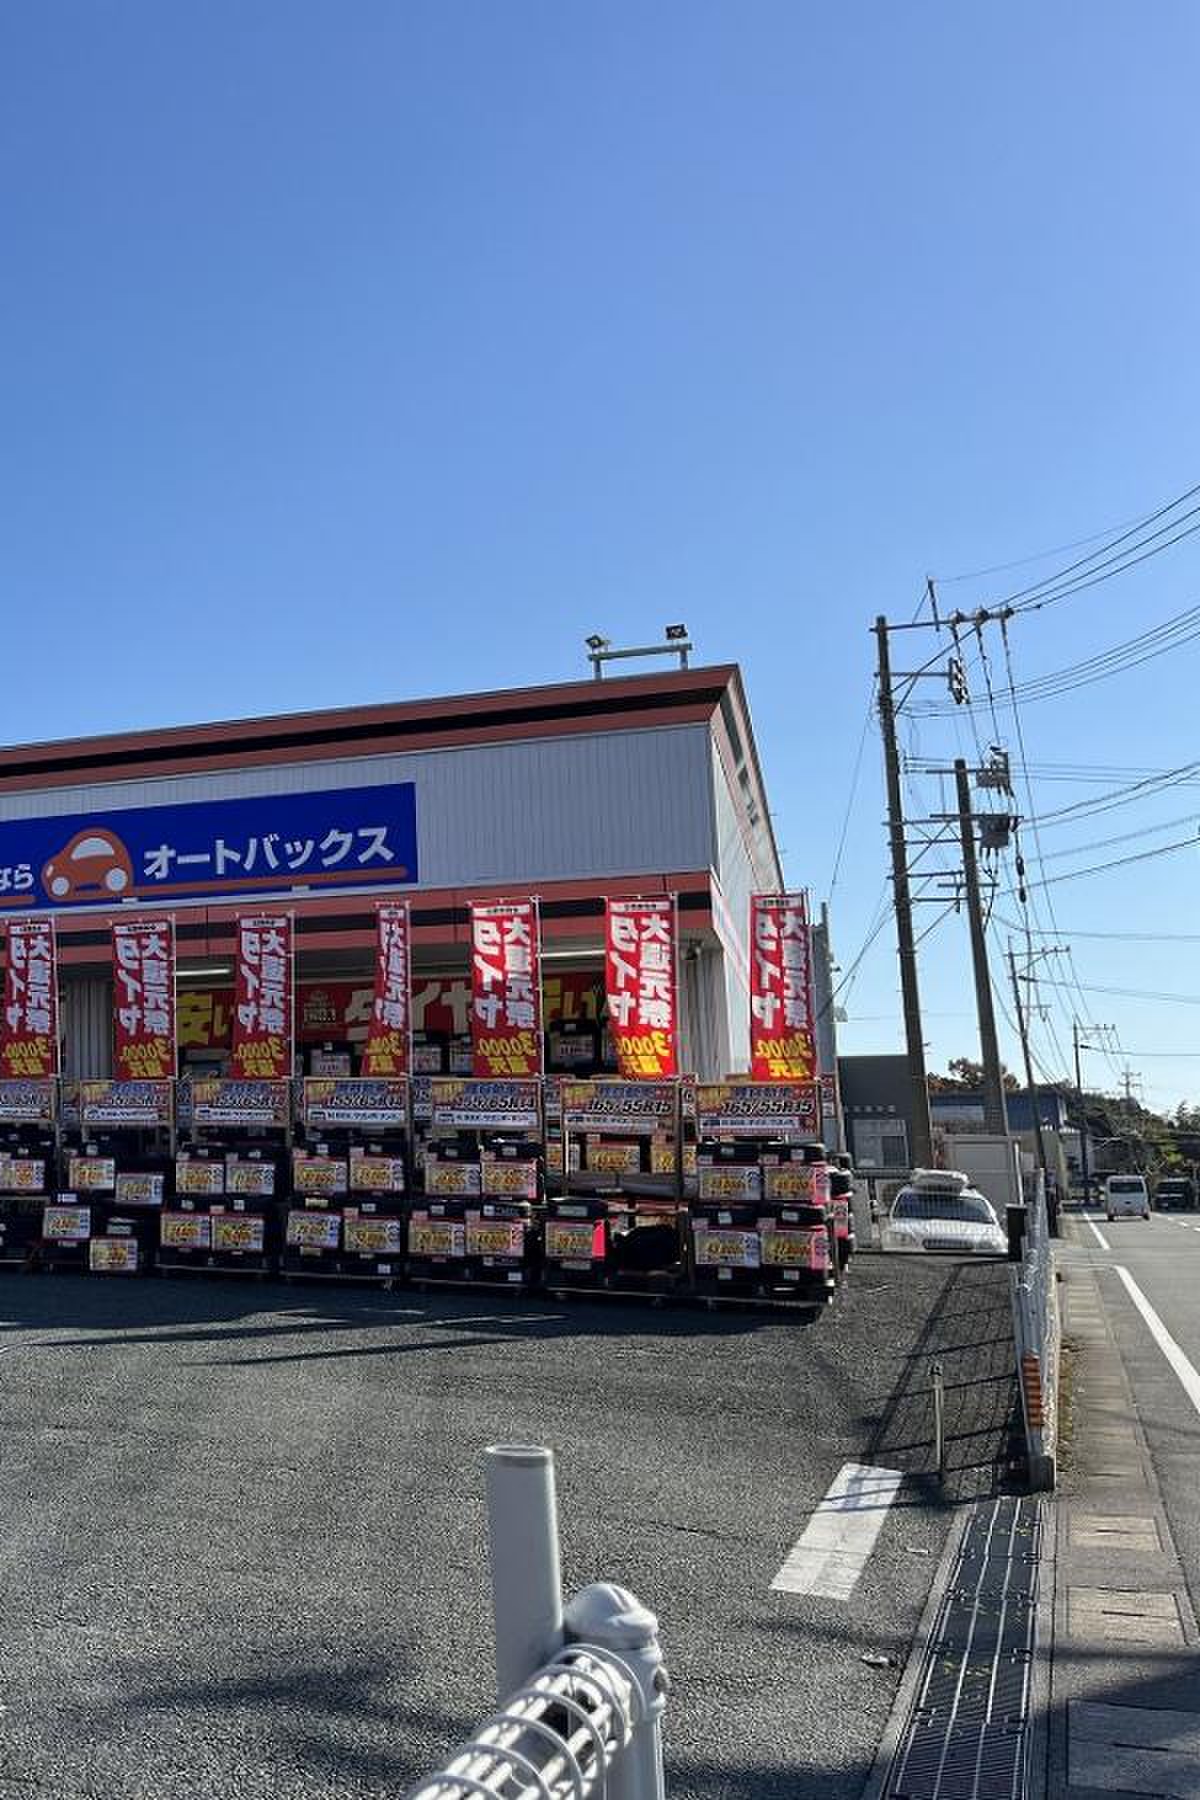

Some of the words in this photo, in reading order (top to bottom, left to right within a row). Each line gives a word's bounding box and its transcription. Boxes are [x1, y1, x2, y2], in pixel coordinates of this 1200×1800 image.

[144, 826, 395, 879] オートバックス
